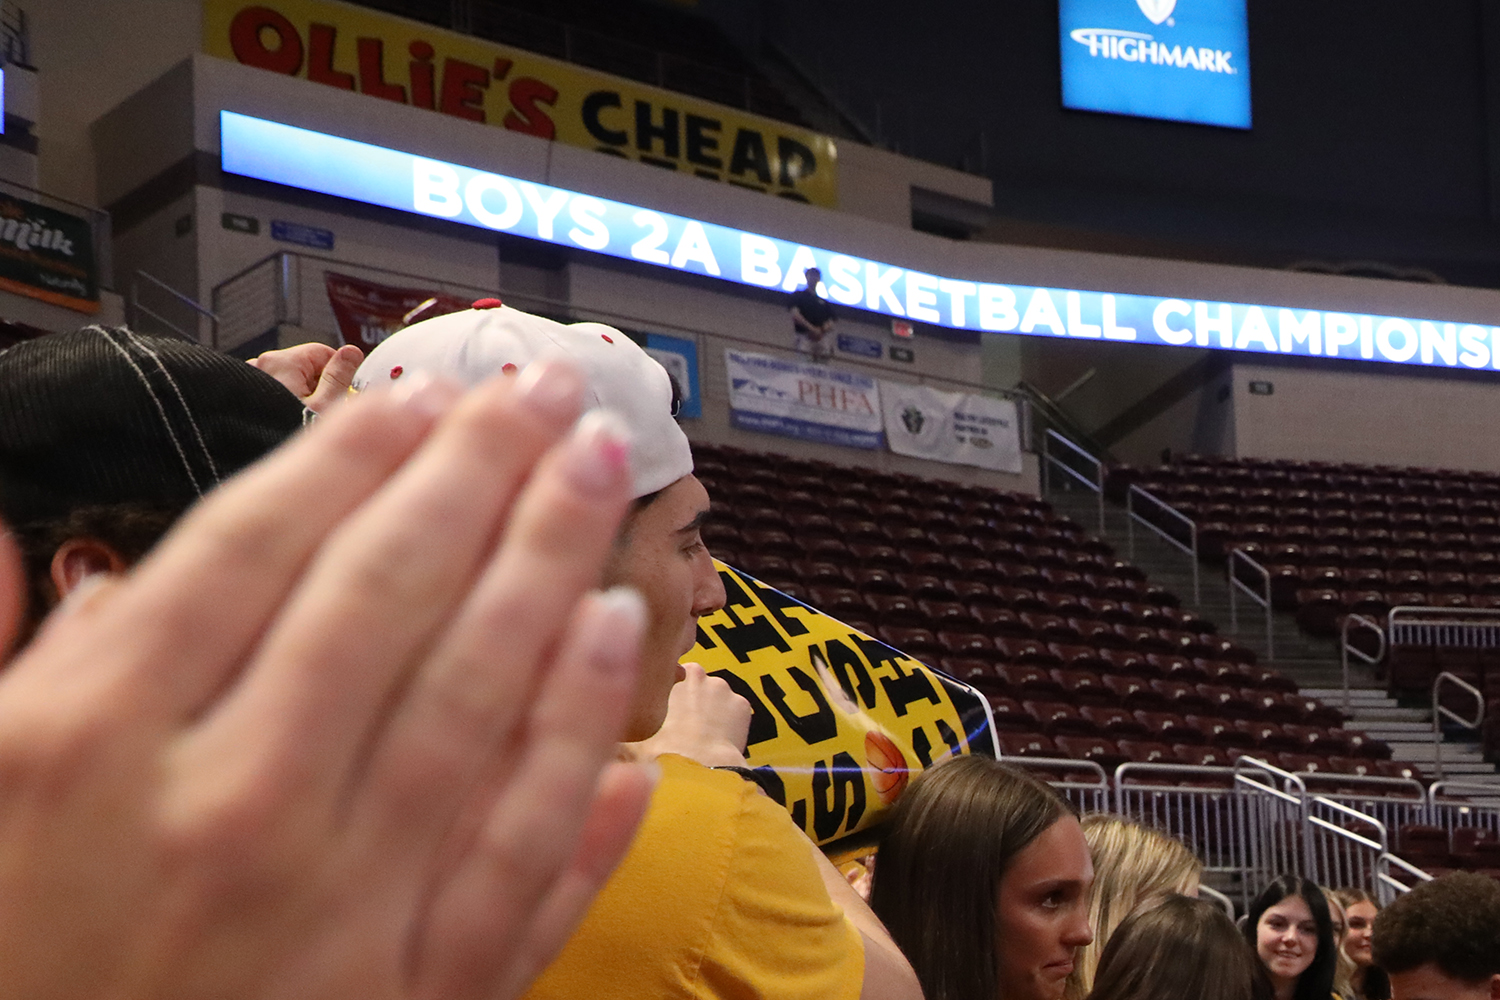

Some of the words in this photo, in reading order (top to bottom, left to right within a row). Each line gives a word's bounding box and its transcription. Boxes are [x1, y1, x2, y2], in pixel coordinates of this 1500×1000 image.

[1070, 28, 1236, 74] HIGHMARK
[581, 90, 817, 189] CHEAP
[411, 157, 611, 251] BOYS
[630, 208, 721, 276] 2A
[739, 232, 1138, 341] BASKETBALL
